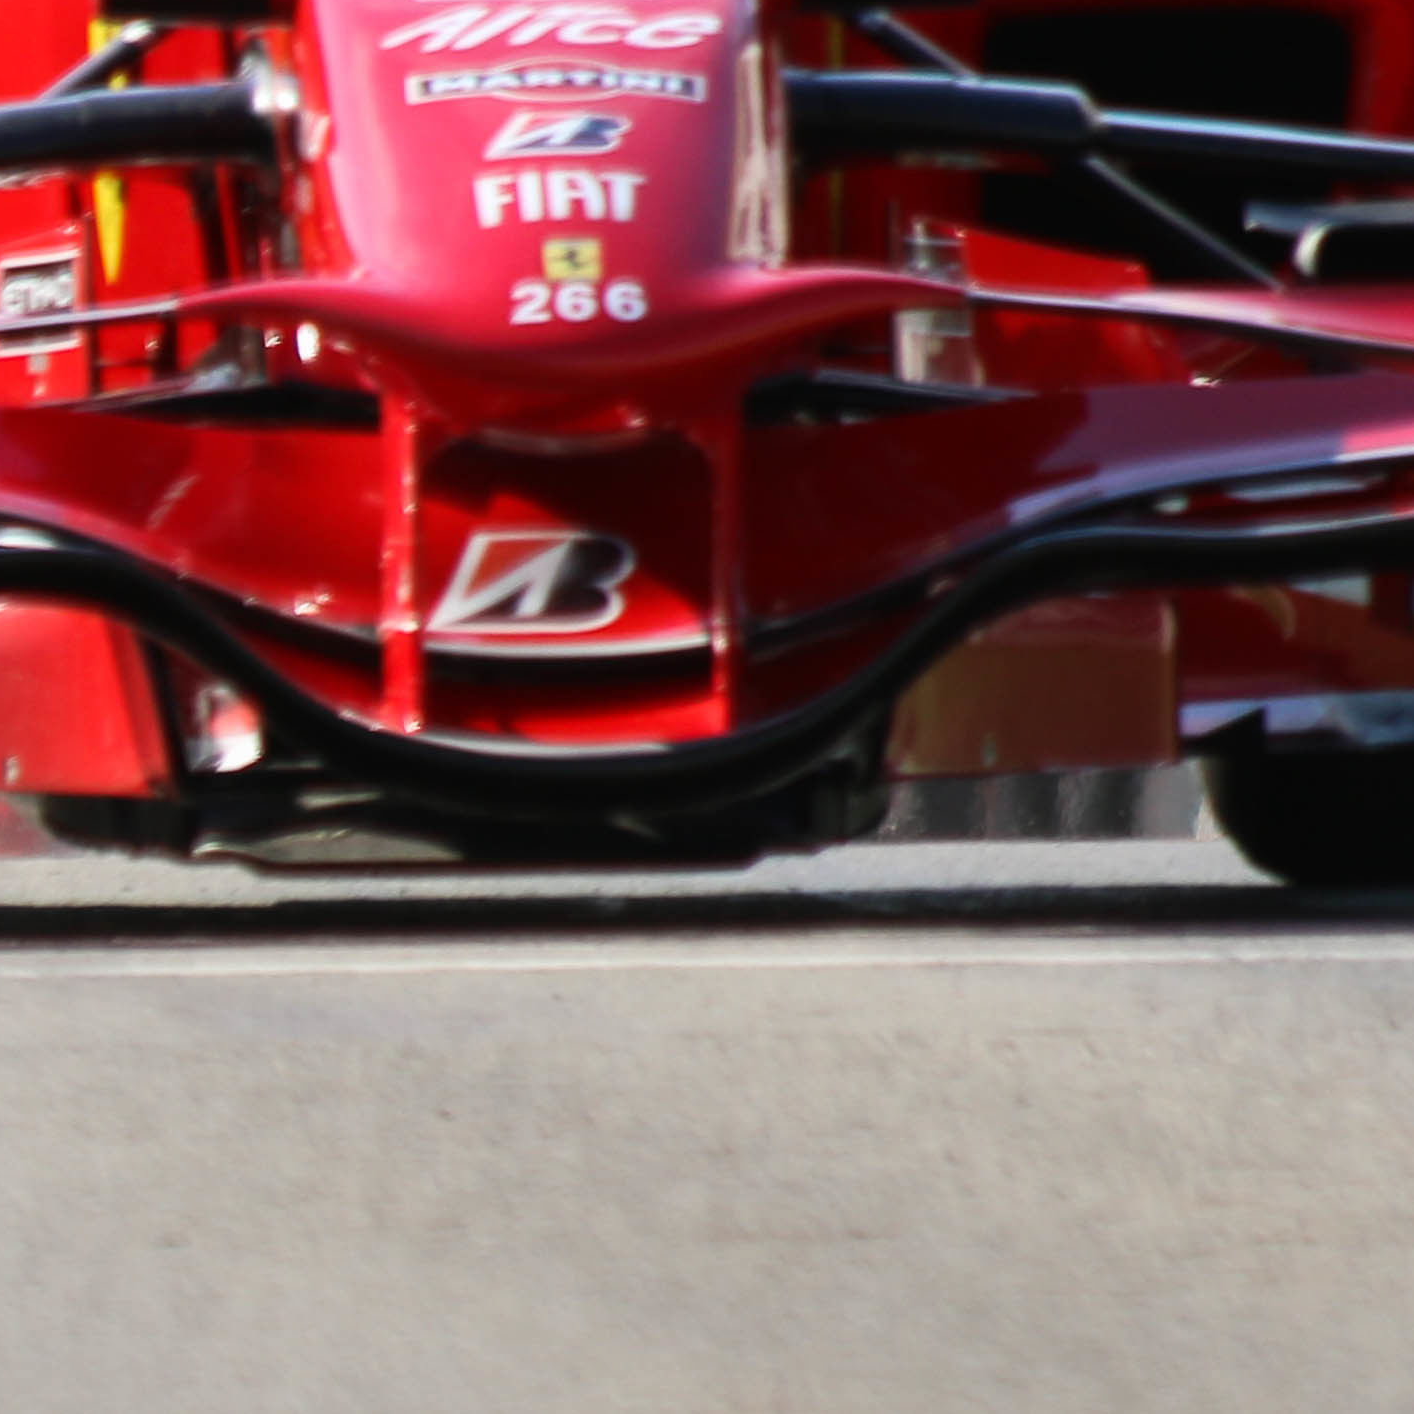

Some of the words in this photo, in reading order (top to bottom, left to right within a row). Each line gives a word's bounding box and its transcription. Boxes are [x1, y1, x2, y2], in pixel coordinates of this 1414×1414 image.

[429, 66, 686, 95] MARTINI
[474, 170, 645, 227] FIAT
[508, 280, 649, 325] 266
